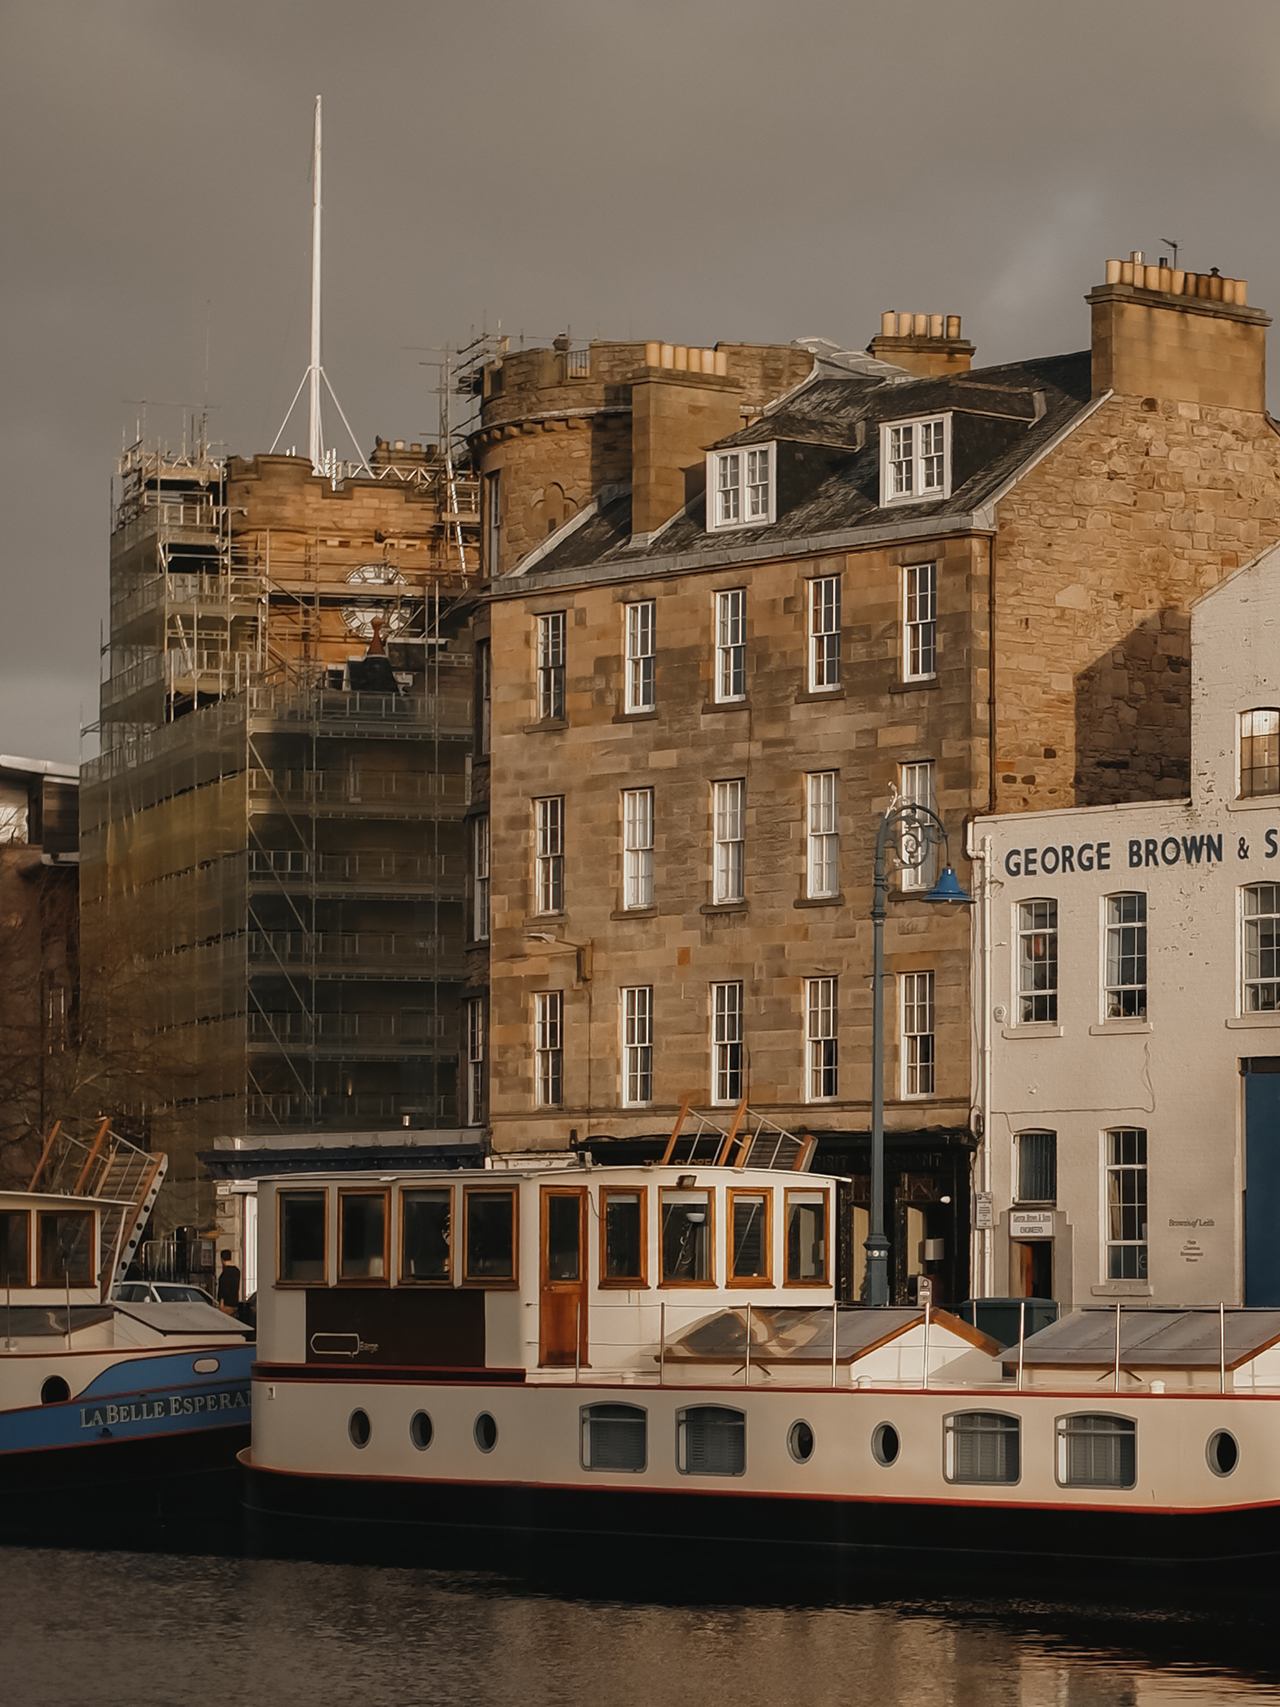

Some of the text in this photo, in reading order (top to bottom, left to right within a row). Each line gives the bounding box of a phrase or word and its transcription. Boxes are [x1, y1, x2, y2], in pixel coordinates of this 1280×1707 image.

[1004, 841, 1111, 877] GEORGE
[1128, 833, 1223, 868] BROWN
[1237, 836, 1250, 860] &
[106, 1401, 166, 1425] BELLE
